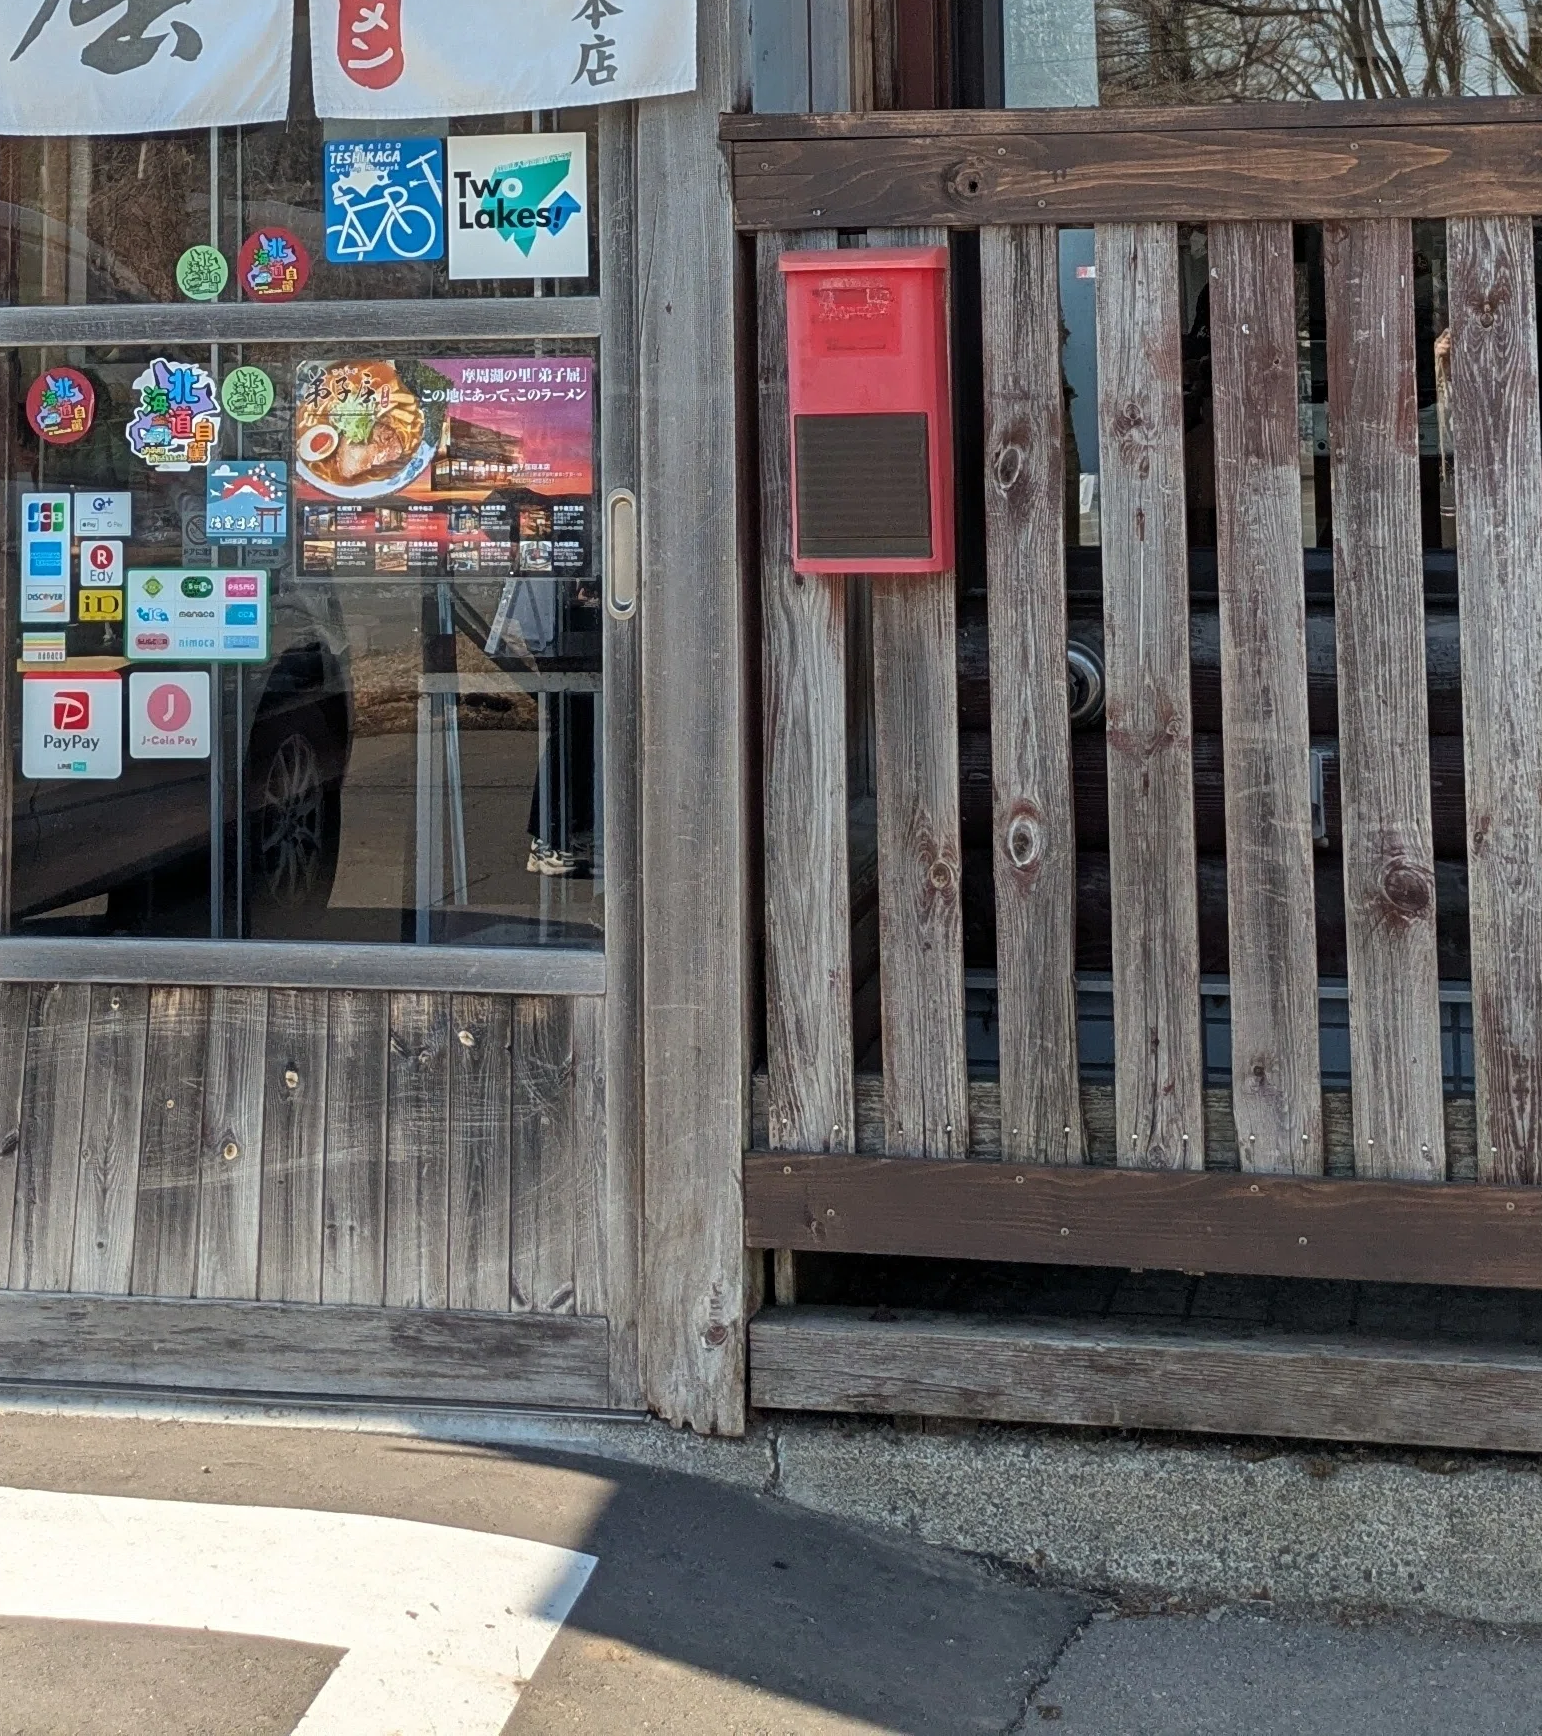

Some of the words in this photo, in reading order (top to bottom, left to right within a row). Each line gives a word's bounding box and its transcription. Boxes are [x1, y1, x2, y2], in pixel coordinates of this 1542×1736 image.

[329, 150, 401, 164] TESHIKAGA
[454, 171, 523, 199] Two
[458, 198, 563, 229] Lakes!
[421, 387, 589, 403] この地にあって、このラーメン
[141, 368, 201, 439] 北海道
[96, 549, 109, 565] R
[90, 569, 114, 583] Edy
[27, 593, 63, 601] DISCOVER
[83, 595, 120, 614] iD
[43, 735, 100, 752] PayPay
[178, 736, 198, 746] Pay
